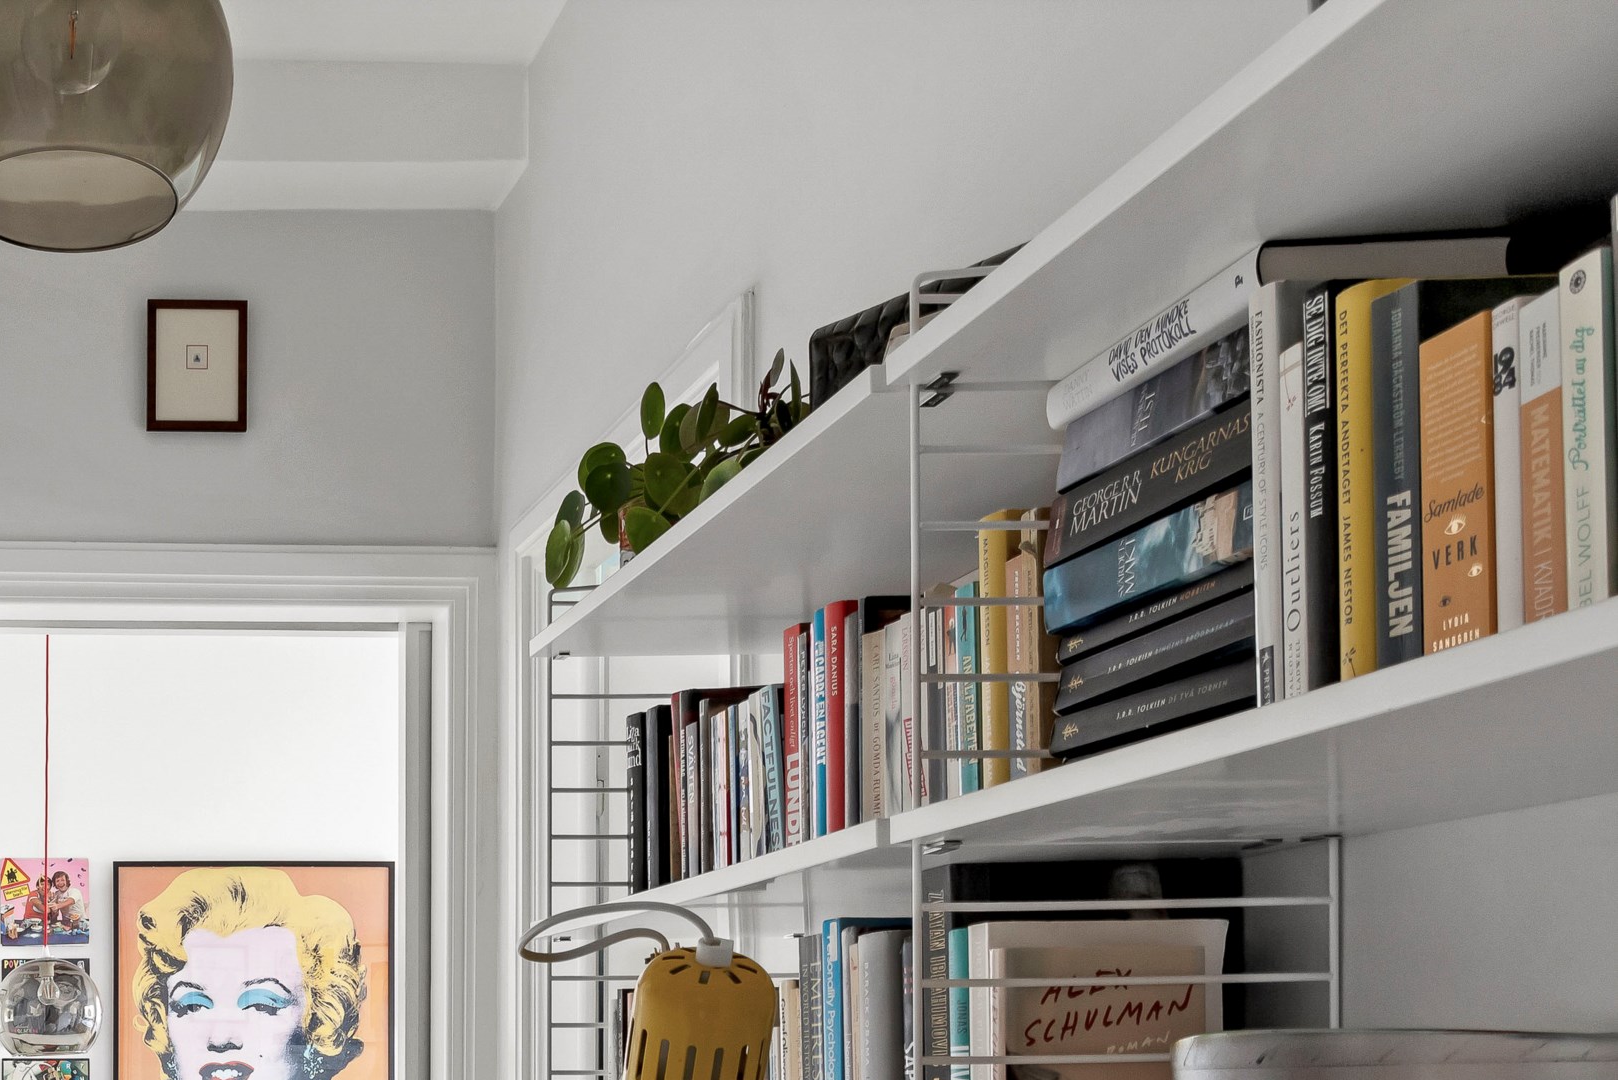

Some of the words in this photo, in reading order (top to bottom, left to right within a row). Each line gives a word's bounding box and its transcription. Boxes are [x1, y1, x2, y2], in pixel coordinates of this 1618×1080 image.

[1305, 294, 1324, 315] SE
[1338, 309, 1348, 332] DET
[1108, 337, 1131, 366] DAVID
[1134, 327, 1151, 349] DEN
[1155, 299, 1190, 332] MINDRE
[1111, 352, 1138, 382] VISES
[1140, 316, 1197, 366] PROTOKOLL
[1306, 316, 1325, 346] DIG
[1254, 310, 1265, 406] FASHIONISTA
[1306, 344, 1325, 386] INTE
[1339, 341, 1349, 414] PERFEKTA
[1257, 411, 1264, 420] A
[1307, 384, 1326, 416] OM!
[1150, 412, 1251, 479] KUNGARNAS
[1256, 423, 1266, 474] CENTURY
[1309, 421, 1325, 466] KARIN
[1340, 419, 1351, 506] ANDETAGET
[1175, 450, 1213, 483] KRIG
[1258, 477, 1266, 496] OF
[1531, 402, 1553, 545] MATEMATIK
[1069, 482, 1142, 537] MARTIN
[1072, 477, 1121, 517] GEORGE
[1309, 465, 1326, 518] FOSSUM
[1424, 482, 1485, 524] Samlade
[1258, 500, 1268, 530] STYLE
[1576, 488, 1591, 566] WOLFF
[1259, 532, 1268, 571] ICONS
[1342, 515, 1352, 561] JAMES
[1432, 534, 1478, 570] VERK
[982, 537, 990, 588] MAJGULL
[1285, 511, 1301, 633] Outliers
[1386, 489, 1414, 639] FAMILJEN
[1148, 596, 1178, 614] TOLKIEN
[1343, 567, 1353, 626] NESTOR
[830, 626, 838, 653] SARA
[1432, 628, 1480, 653] SANDGREN
[1442, 612, 1470, 632] LYDIA
[787, 635, 796, 675] Sporten
[1126, 650, 1153, 667] TOLKIEN
[788, 678, 796, 695] och
[831, 656, 839, 697] DANIUS
[872, 676, 880, 717] SANTOS
[1137, 698, 1166, 714] TOLKIEN
[1179, 687, 1194, 702] TVÅ
[1197, 679, 1228, 696] TORNEN
[788, 696, 796, 718] livet
[788, 720, 796, 748] enligt
[687, 734, 696, 804] SVÄLTEN
[872, 736, 881, 776] GÖMDA
[928, 889, 946, 952] ZATAN
[802, 964, 808, 978] IN
[802, 981, 810, 1026] WORLD
[810, 961, 823, 1080] EMPIRES
[956, 1000, 967, 1034] JONAS
[1023, 983, 1194, 1047] SCHULMAN
[803, 1028, 811, 1080] HISTORY
